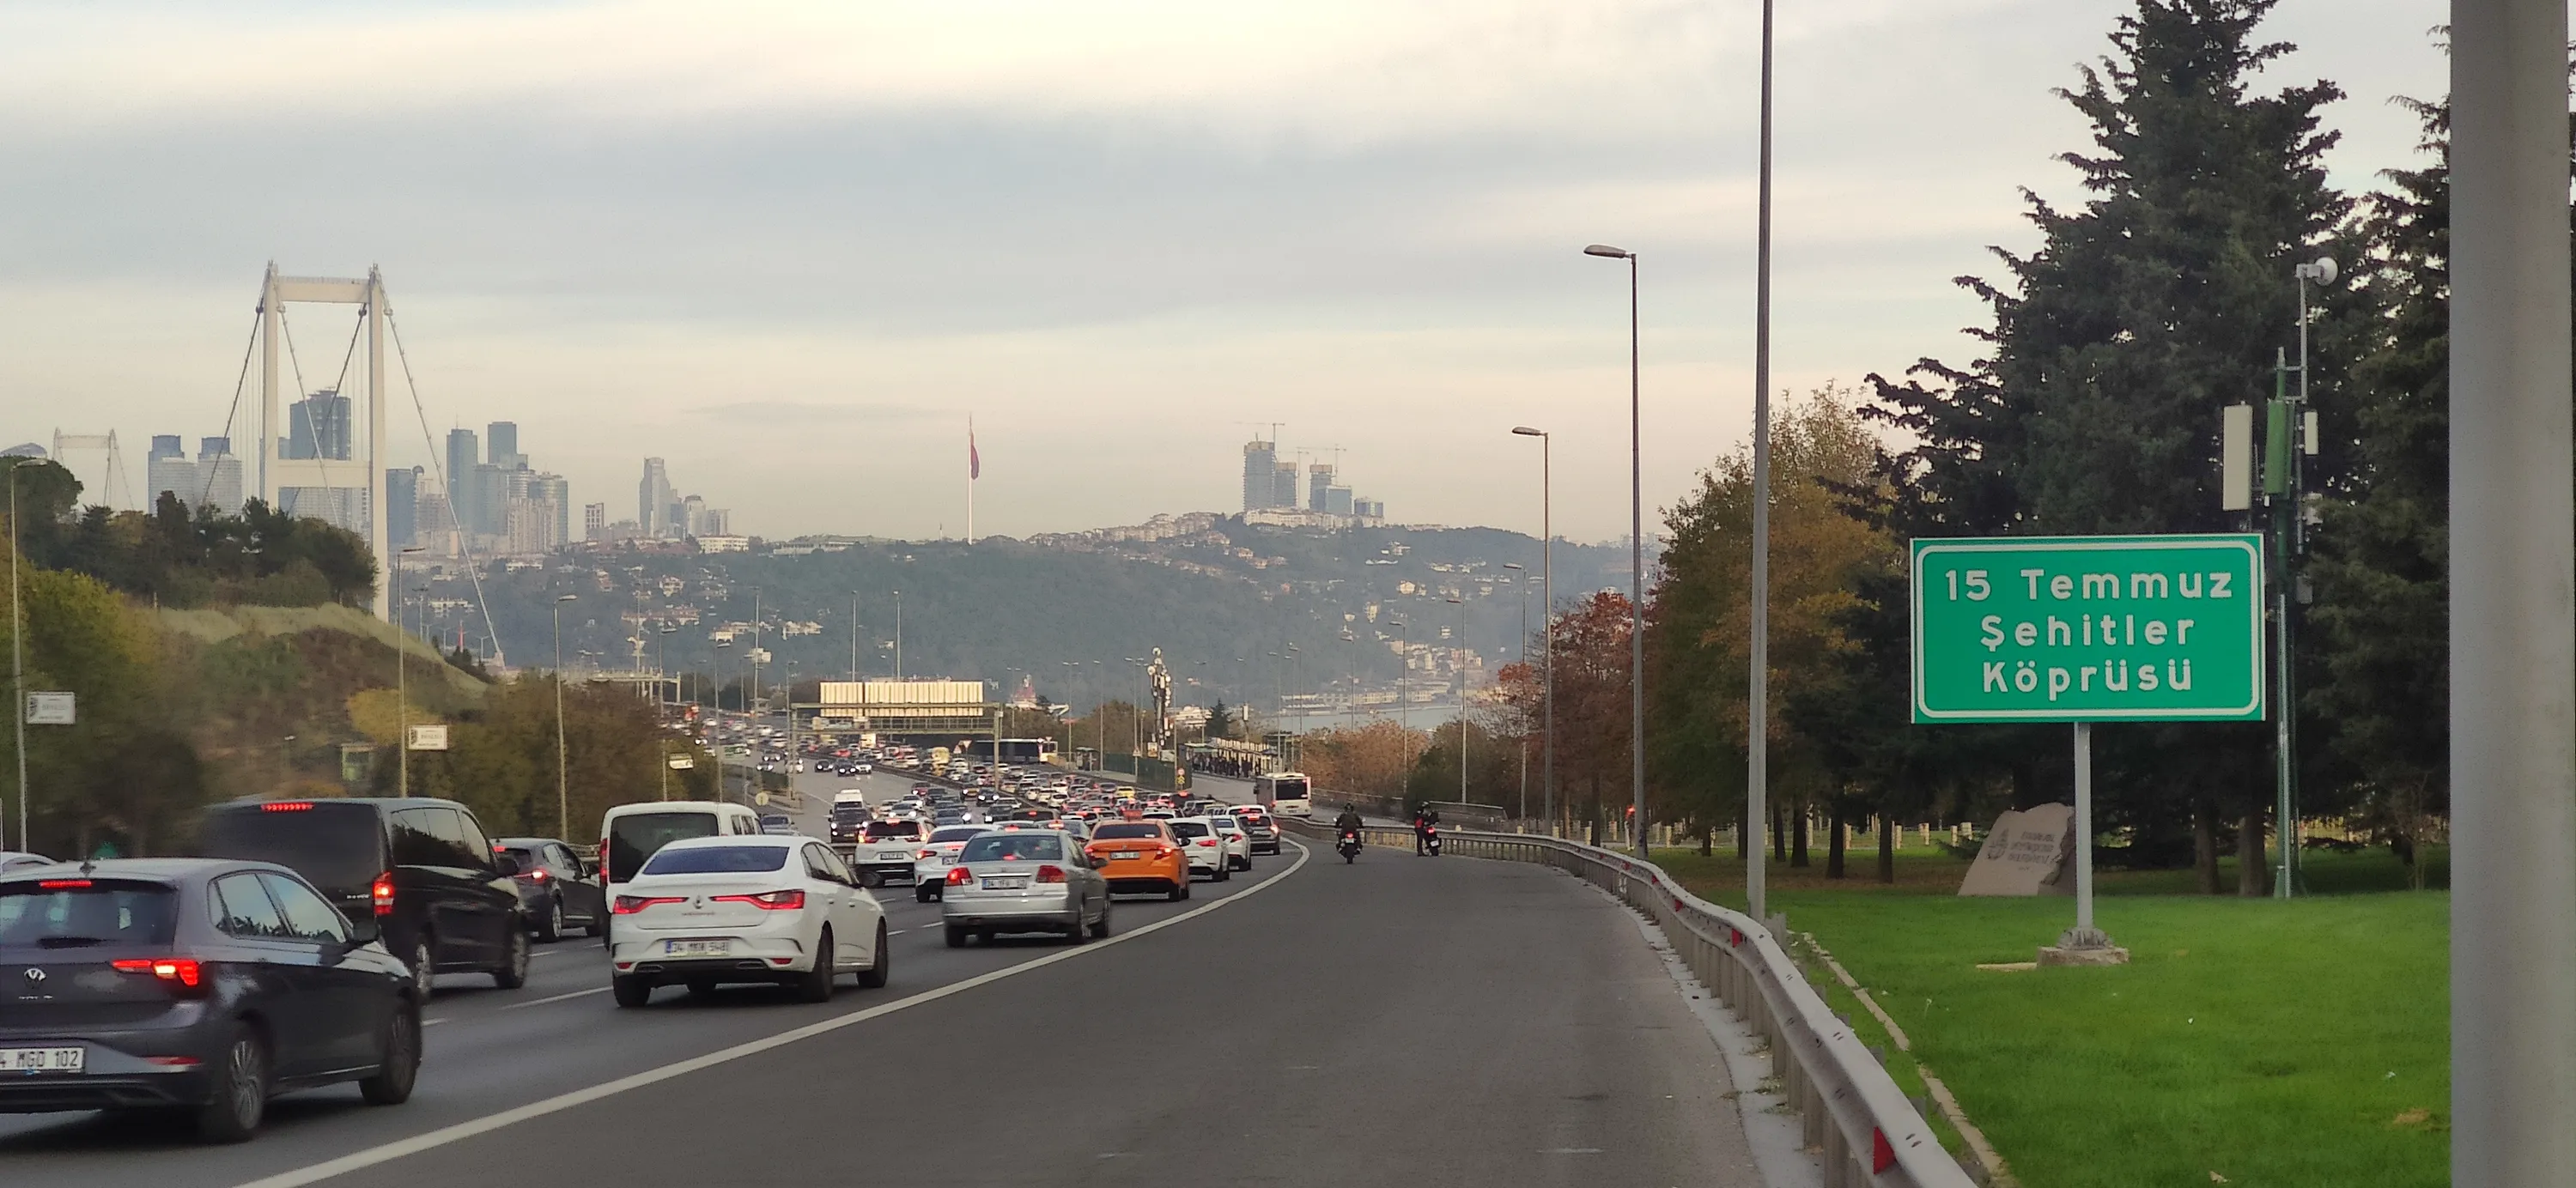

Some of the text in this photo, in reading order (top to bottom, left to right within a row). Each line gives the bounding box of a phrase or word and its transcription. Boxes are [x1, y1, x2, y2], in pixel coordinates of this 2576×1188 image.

[1946, 569, 2232, 601] 15 Temmuz
[1981, 614, 2195, 652] Şehitler
[1984, 659, 2191, 701] Köprüsü
[55, 1050, 79, 1067] 102
